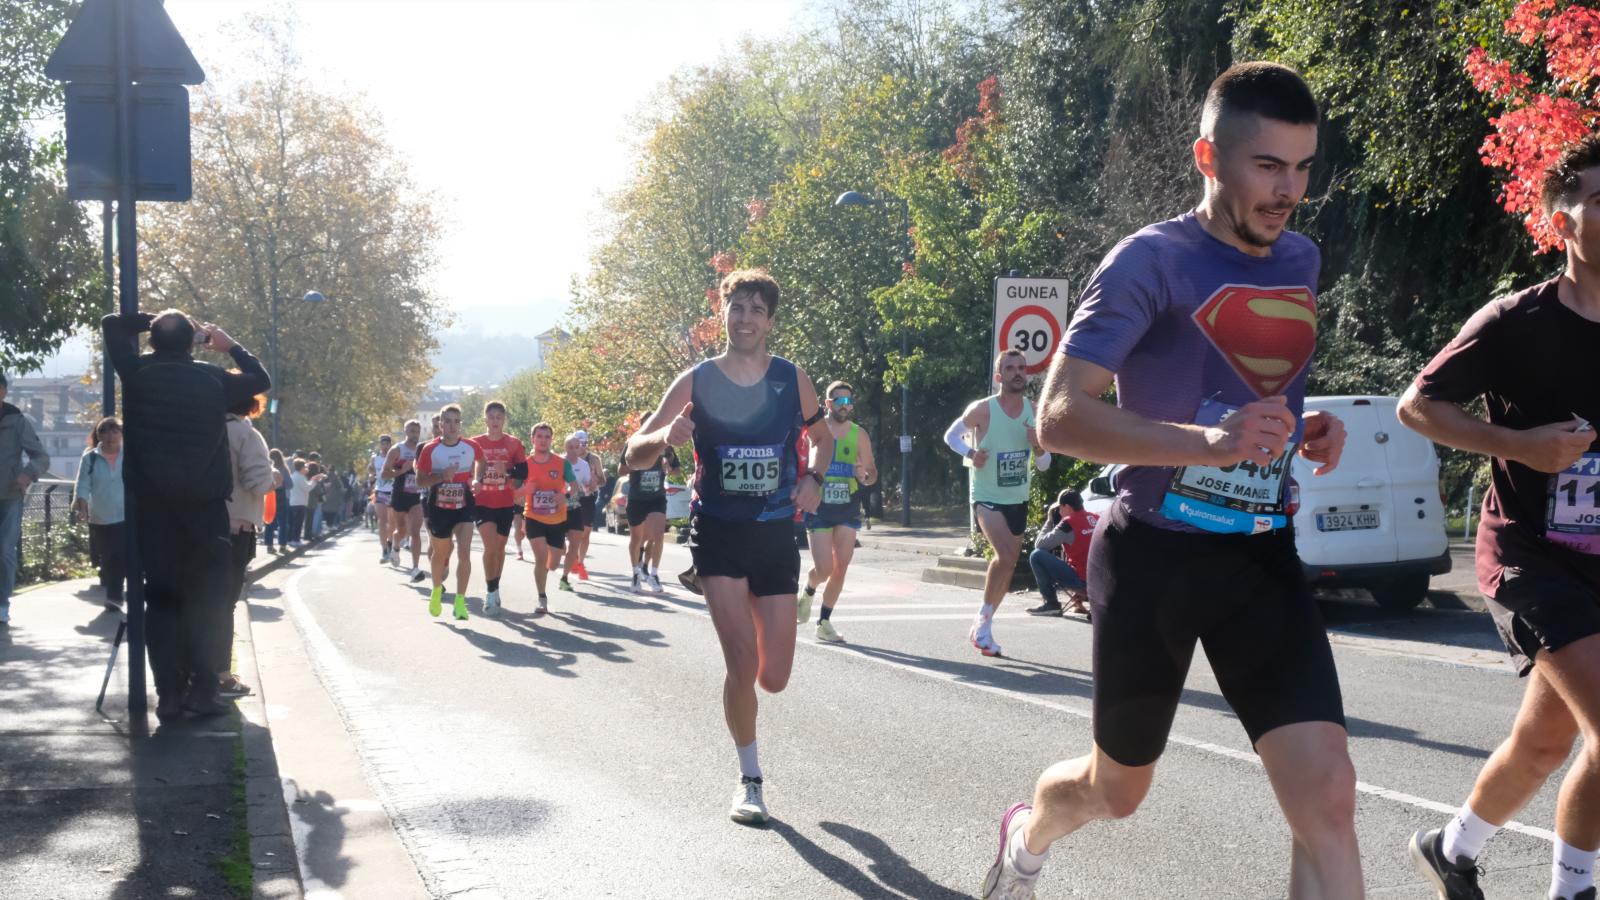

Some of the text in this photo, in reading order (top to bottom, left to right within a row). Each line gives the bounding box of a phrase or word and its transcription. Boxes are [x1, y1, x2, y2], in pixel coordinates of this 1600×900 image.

[1006, 286, 1058, 299] GUNEA
[1015, 330, 1048, 352] 30
[723, 461, 779, 480] 2105
[1196, 476, 1231, 493] JOSE
[1326, 513, 1376, 528] 3924 KHH
